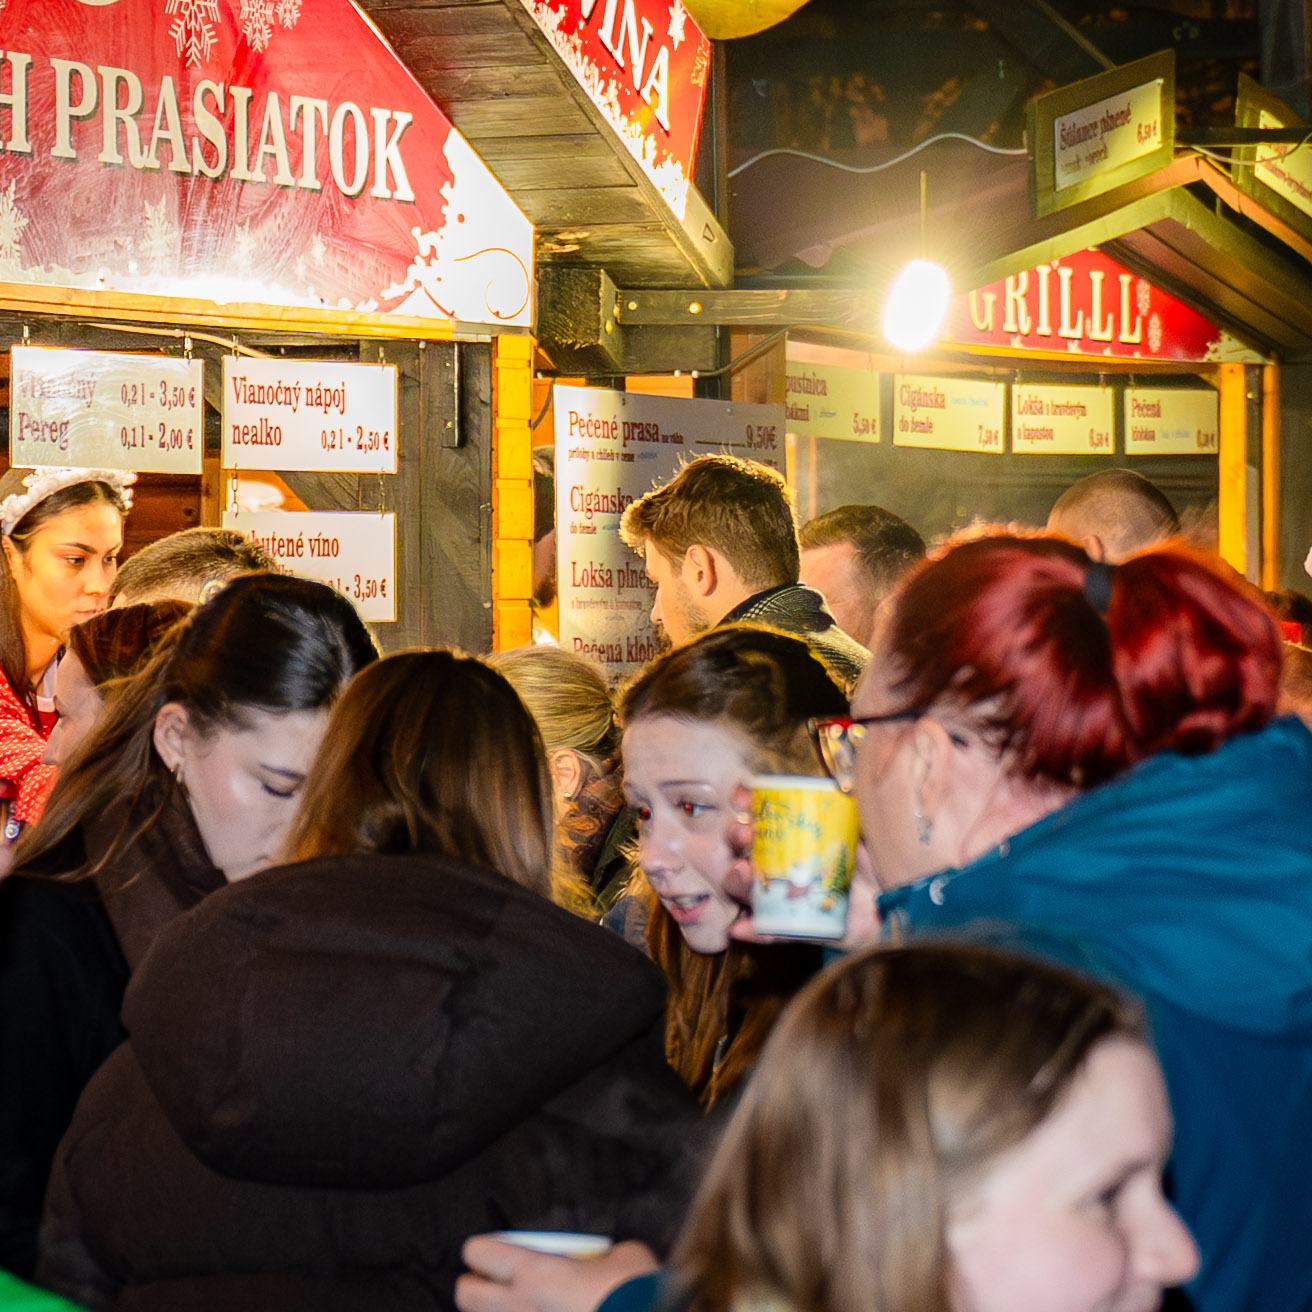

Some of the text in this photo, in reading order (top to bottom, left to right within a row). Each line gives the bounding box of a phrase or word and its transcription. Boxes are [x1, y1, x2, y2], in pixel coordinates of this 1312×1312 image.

[50, 56, 416, 204] PRASIATOK
[160, 380, 185, 410] 3,50
[232, 376, 346, 415] Vianočný nápoj
[785, 372, 827, 398] pustnica
[899, 384, 945, 412] Cigánska
[17, 412, 70, 451] Pereg
[158, 422, 183, 452] 2,00
[232, 417, 282, 446] nealko
[356, 425, 380, 453] 2,50
[568, 410, 619, 440] Pečené
[622, 420, 660, 447] prasa
[308, 531, 340, 558] víno
[353, 574, 377, 602] 3,50
[571, 561, 613, 588] Lokša
[626, 635, 655, 663] klob
